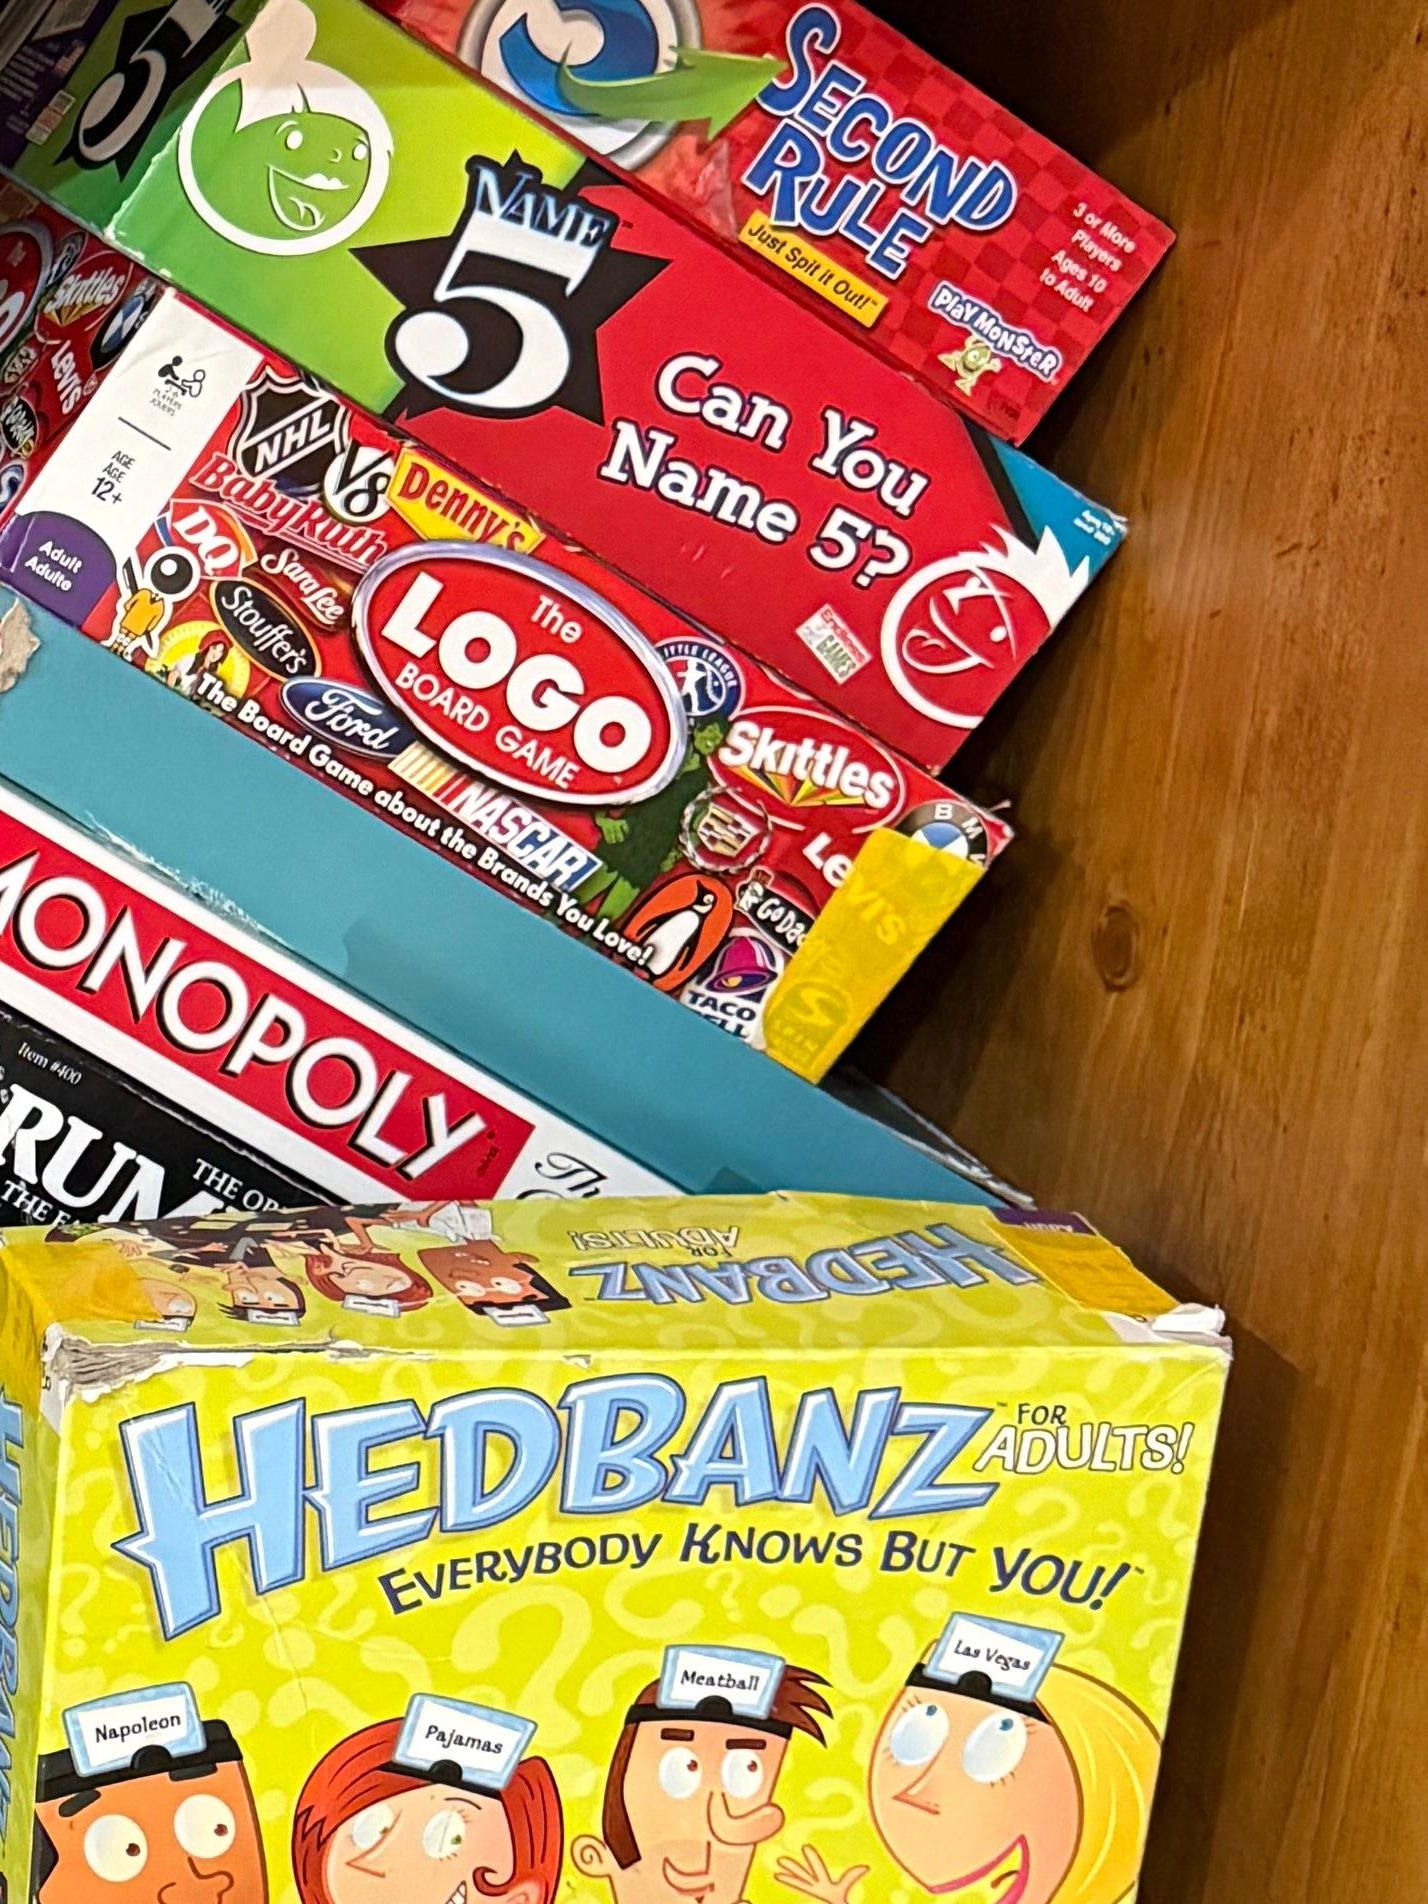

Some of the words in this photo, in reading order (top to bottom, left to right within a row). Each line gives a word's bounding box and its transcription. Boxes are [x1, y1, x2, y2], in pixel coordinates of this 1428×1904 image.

[754, 2, 1018, 234] SECOND
[394, 212, 602, 412] 5
[254, 410, 331, 480] NHL
[655, 351, 792, 452] Can
[809, 406, 930, 520] You
[176, 509, 244, 577] DQ
[396, 460, 528, 554] Denny's
[599, 420, 800, 544] Name
[806, 505, 913, 591] 5?
[38, 539, 83, 573] Adult
[221, 584, 310, 678] Stouffer's
[382, 571, 652, 774] LOGO
[305, 691, 393, 753] Ford
[717, 719, 895, 812] Skittles
[454, 781, 585, 892] NASCAR
[687, 990, 757, 1022] TACO
[974, 1419, 1193, 1478] ADULTS!
[1016, 1402, 1069, 1429] FOR
[112, 1370, 1004, 1642] HEDBANZ
[377, 1527, 664, 1618] EVERYBODY
[678, 1521, 867, 1569] KNOWS
[879, 1530, 976, 1579] BUT
[989, 1558, 1131, 1613] YOU!
[679, 1670, 761, 1696] Meatball
[954, 1640, 983, 1663] Las
[984, 1648, 1033, 1673] Vegas
[93, 1707, 184, 1745] Napoleon
[424, 1722, 505, 1757] Pajamas
